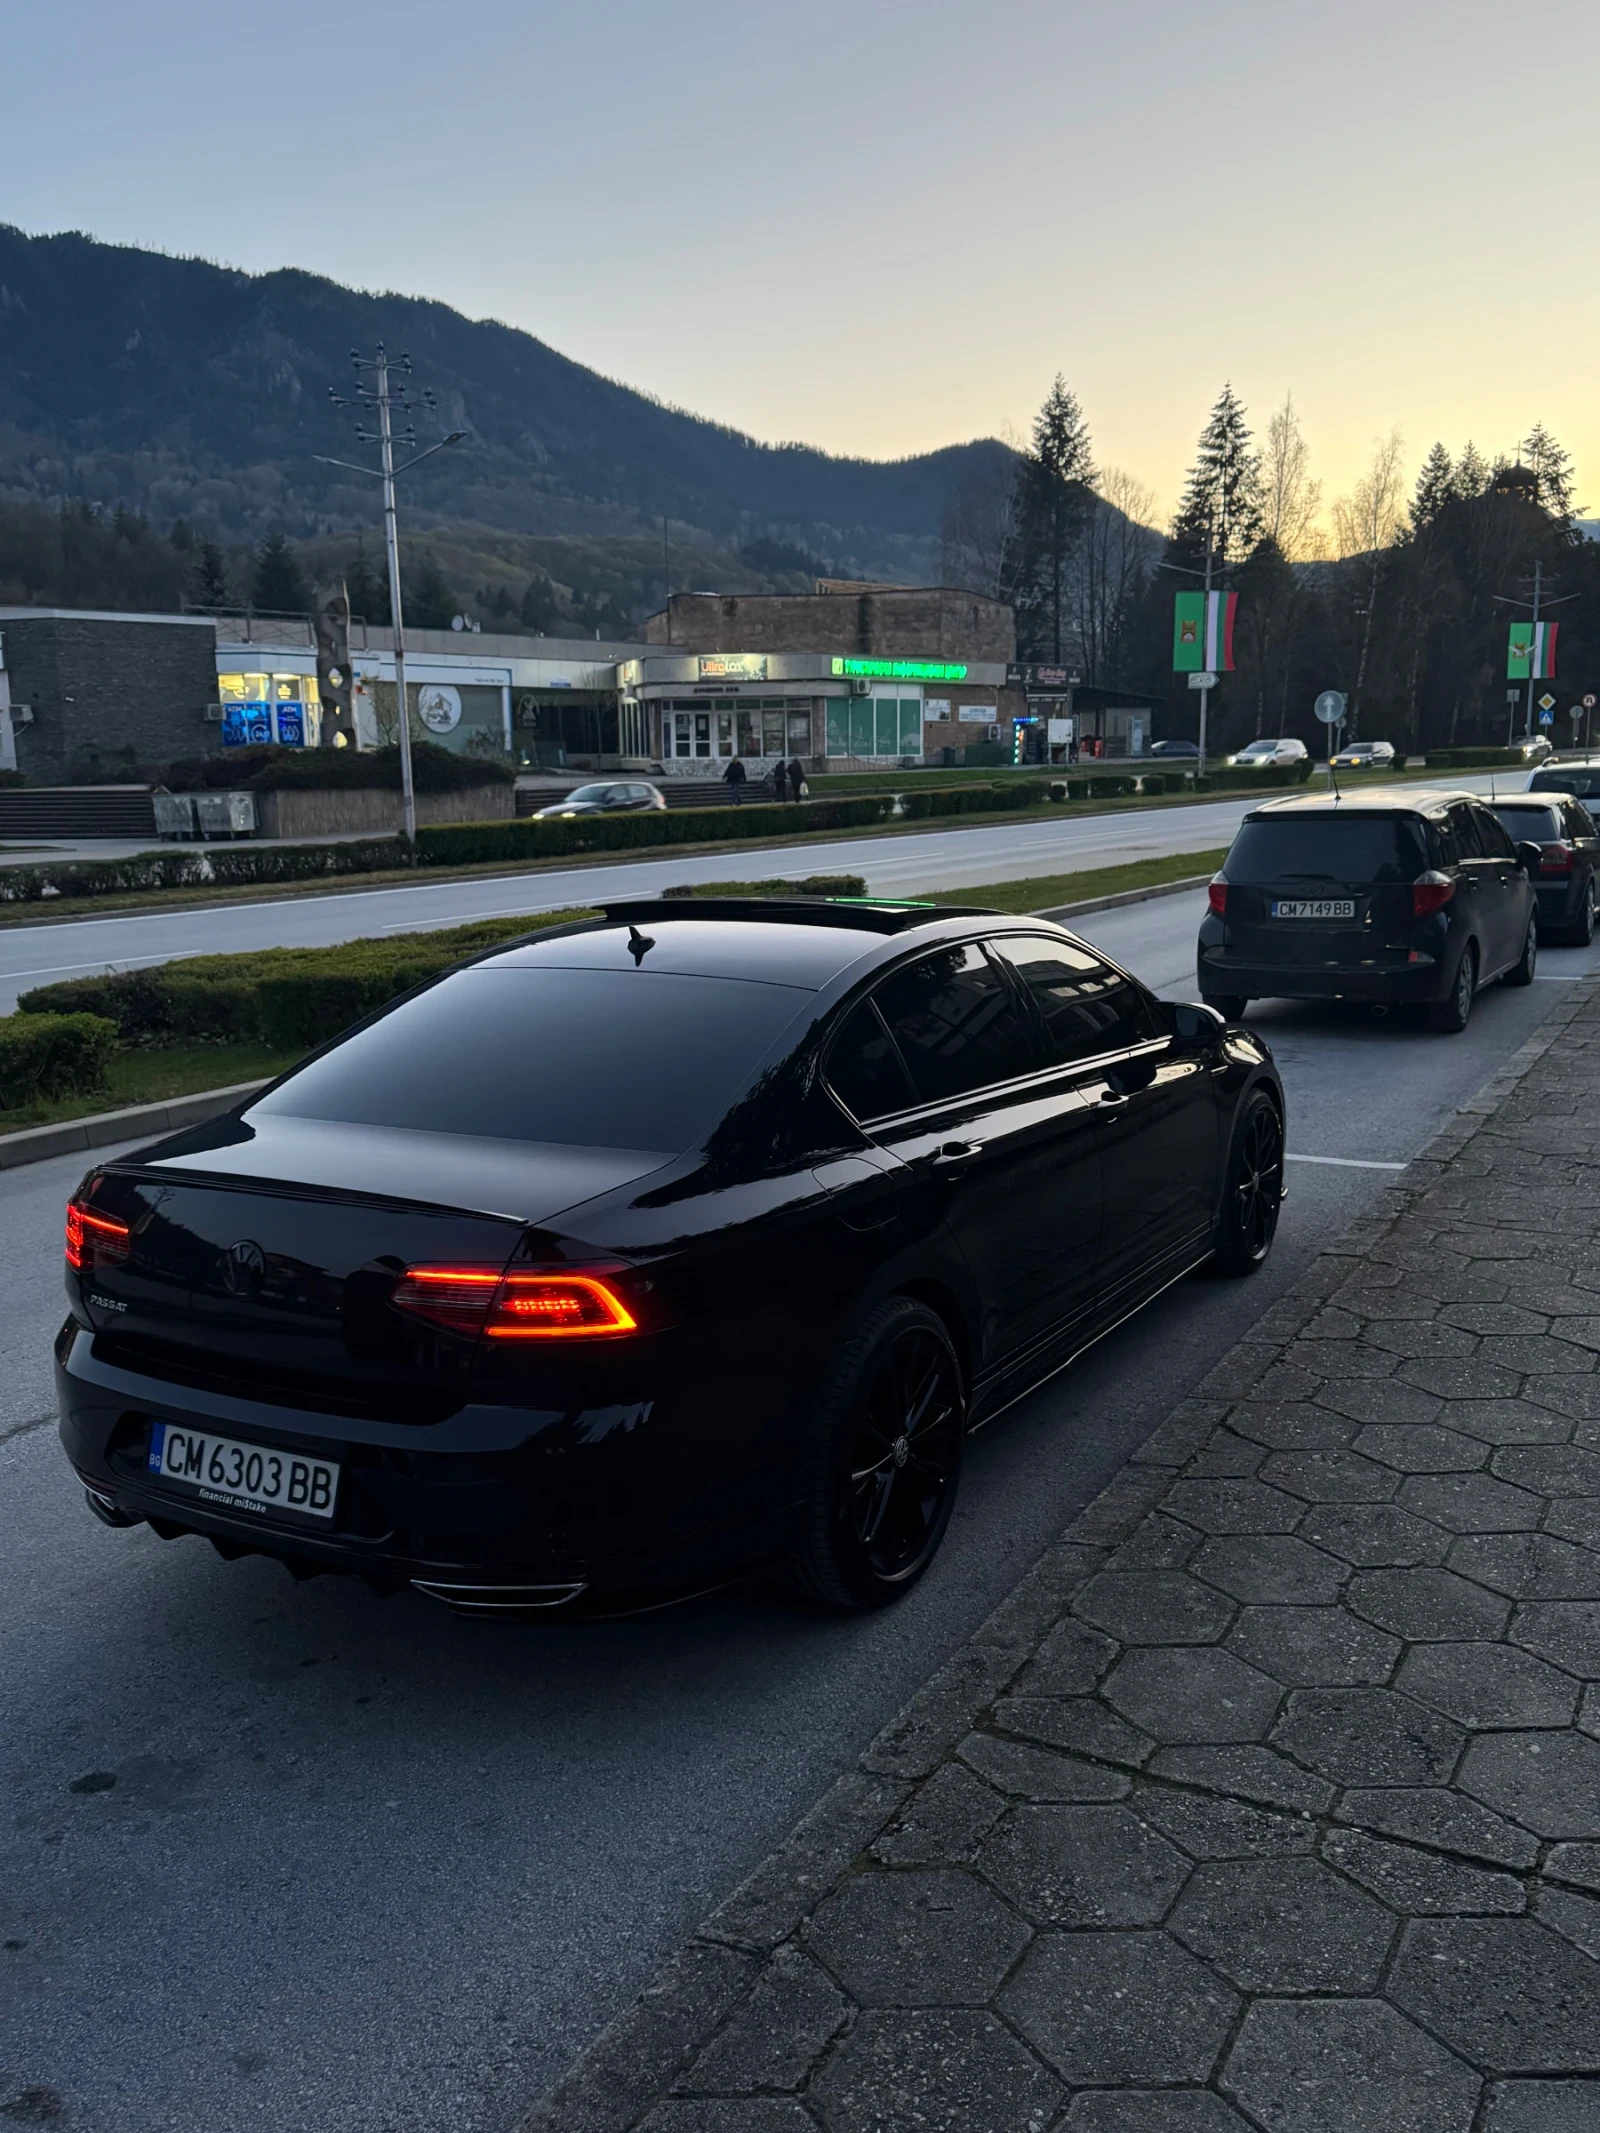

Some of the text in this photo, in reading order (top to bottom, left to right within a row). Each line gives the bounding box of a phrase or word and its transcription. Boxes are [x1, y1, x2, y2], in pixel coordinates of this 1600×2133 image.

[90, 1294, 128, 1312] PASSAT
[149, 1453, 162, 1467] BG
[198, 1487, 267, 1514] financial mi$take
